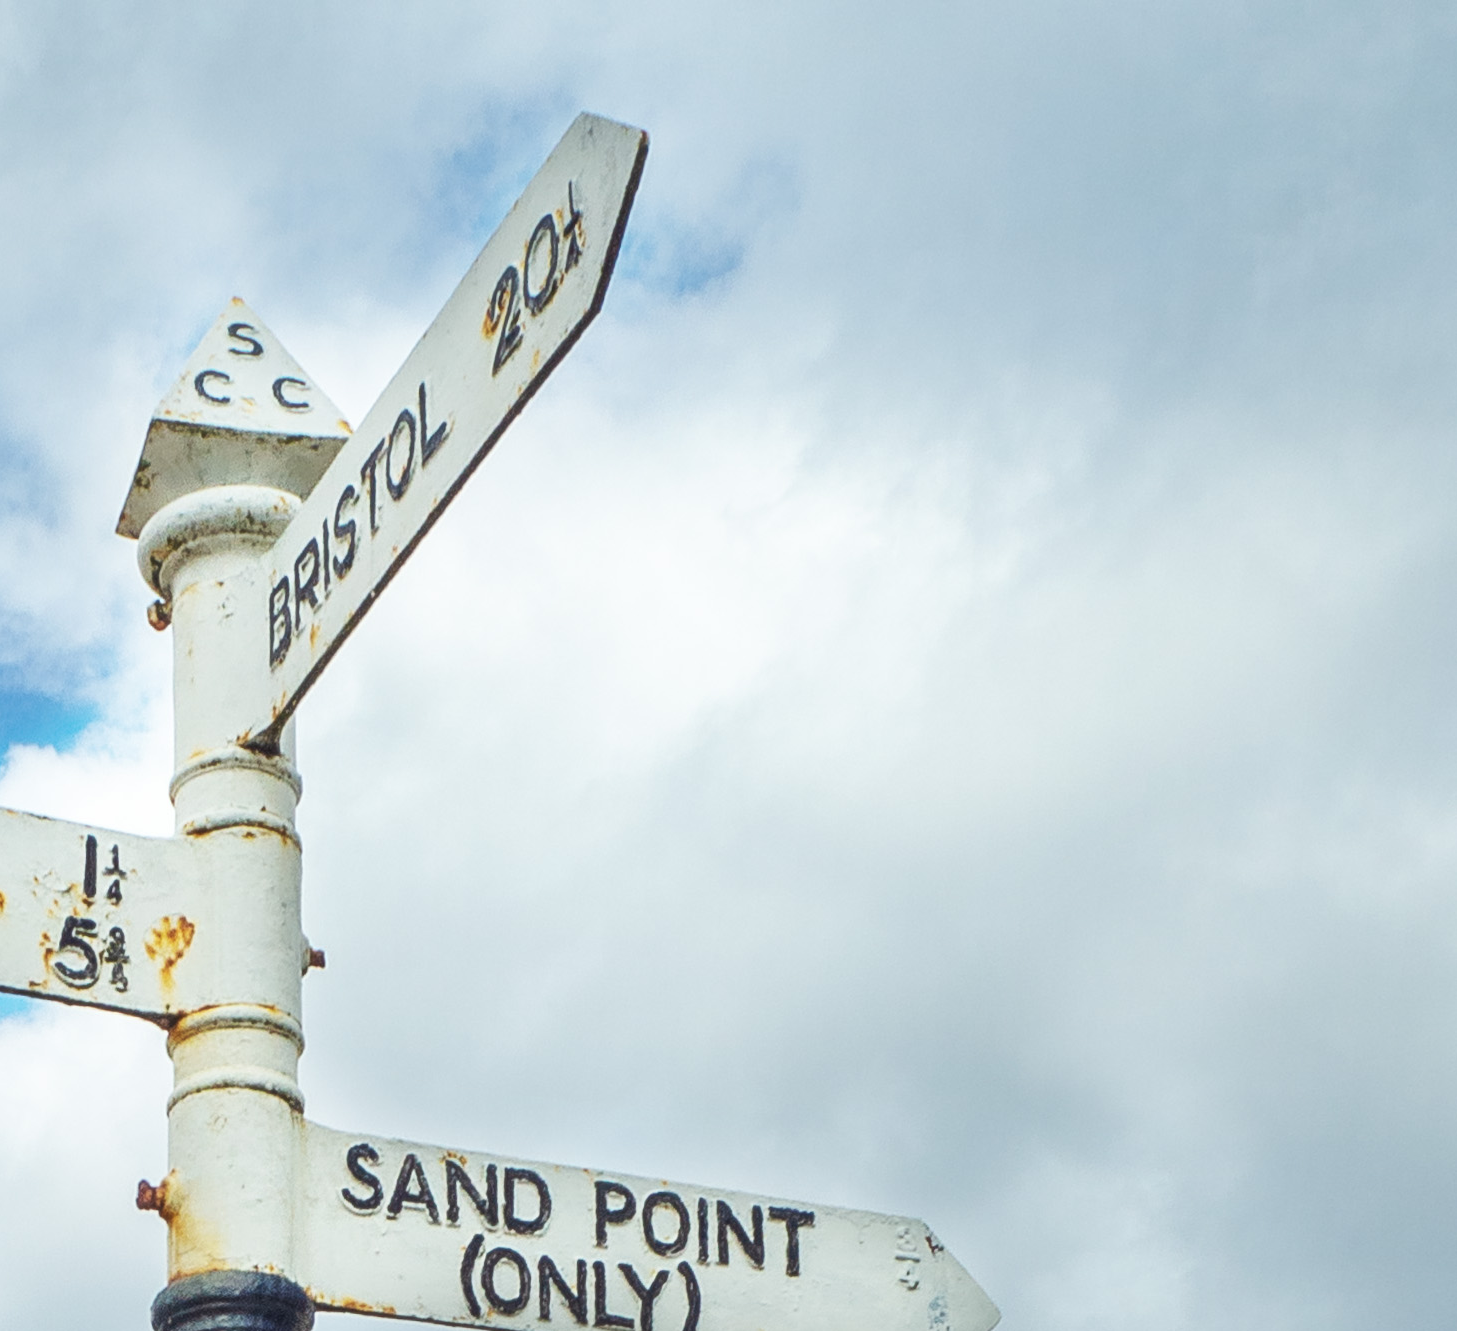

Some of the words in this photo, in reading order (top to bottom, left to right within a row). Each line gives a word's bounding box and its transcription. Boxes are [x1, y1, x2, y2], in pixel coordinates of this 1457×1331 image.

[268, 381, 448, 669] BRISTOL
[342, 1142, 553, 1236] SAND
[594, 1180, 816, 1278] POINT
